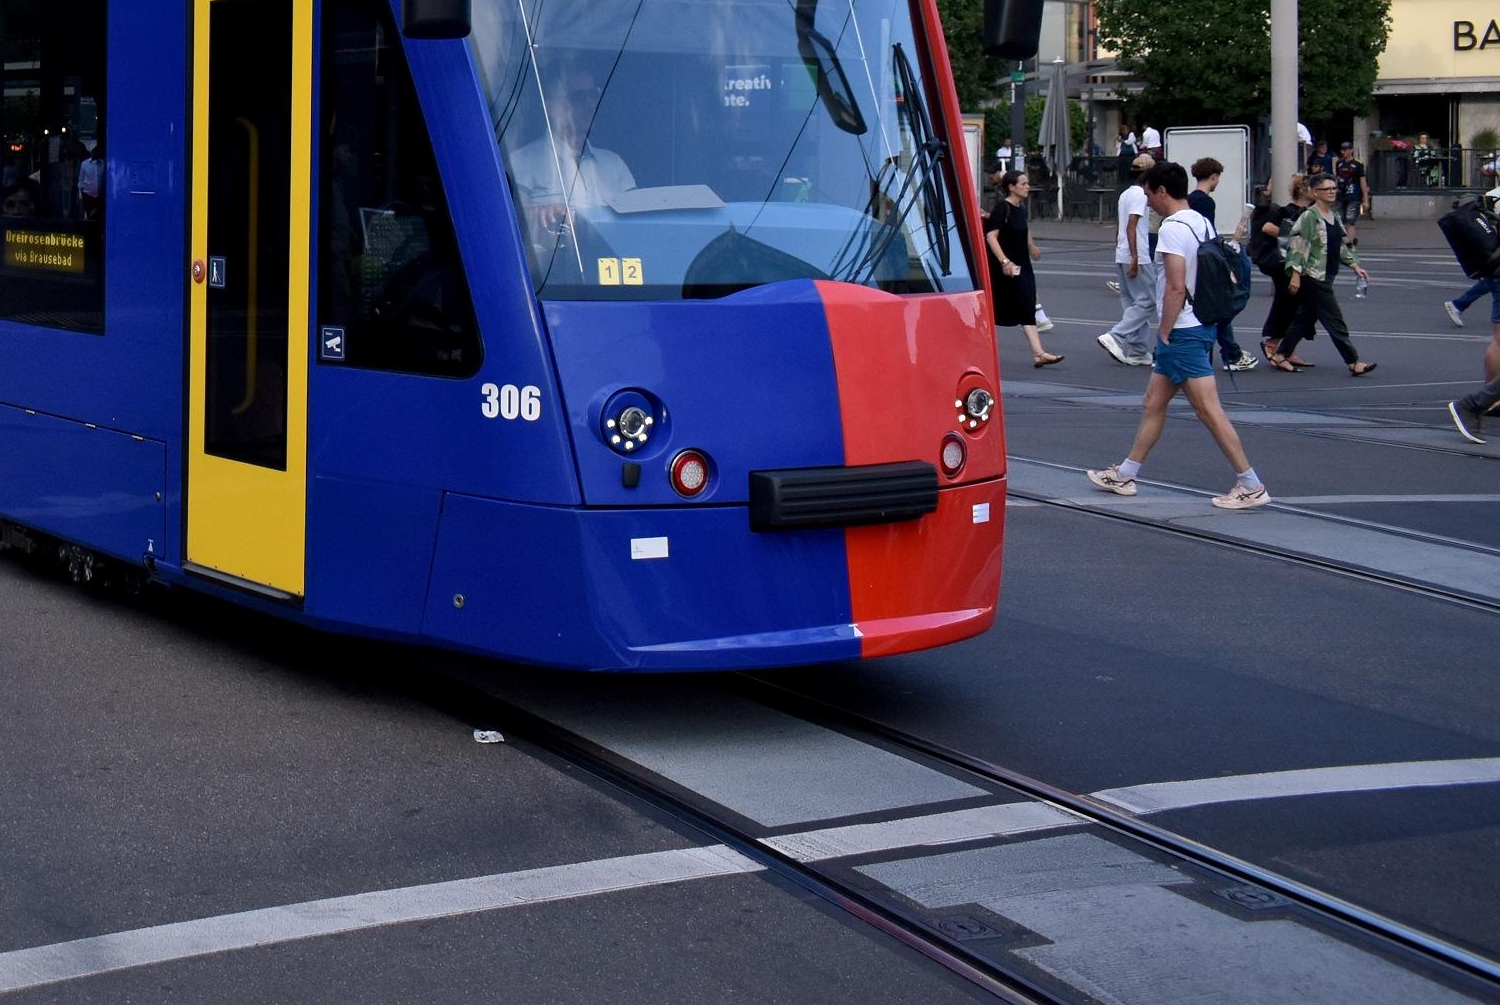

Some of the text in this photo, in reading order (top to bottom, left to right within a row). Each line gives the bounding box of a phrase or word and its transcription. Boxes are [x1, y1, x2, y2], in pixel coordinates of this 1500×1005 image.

[1454, 19, 1500, 52] BA
[6, 229, 84, 249] Dreirosenbrücke
[15, 250, 73, 269] via Brausebad
[605, 265, 613, 278] 1
[627, 265, 637, 279] 2
[481, 383, 541, 422] 306
